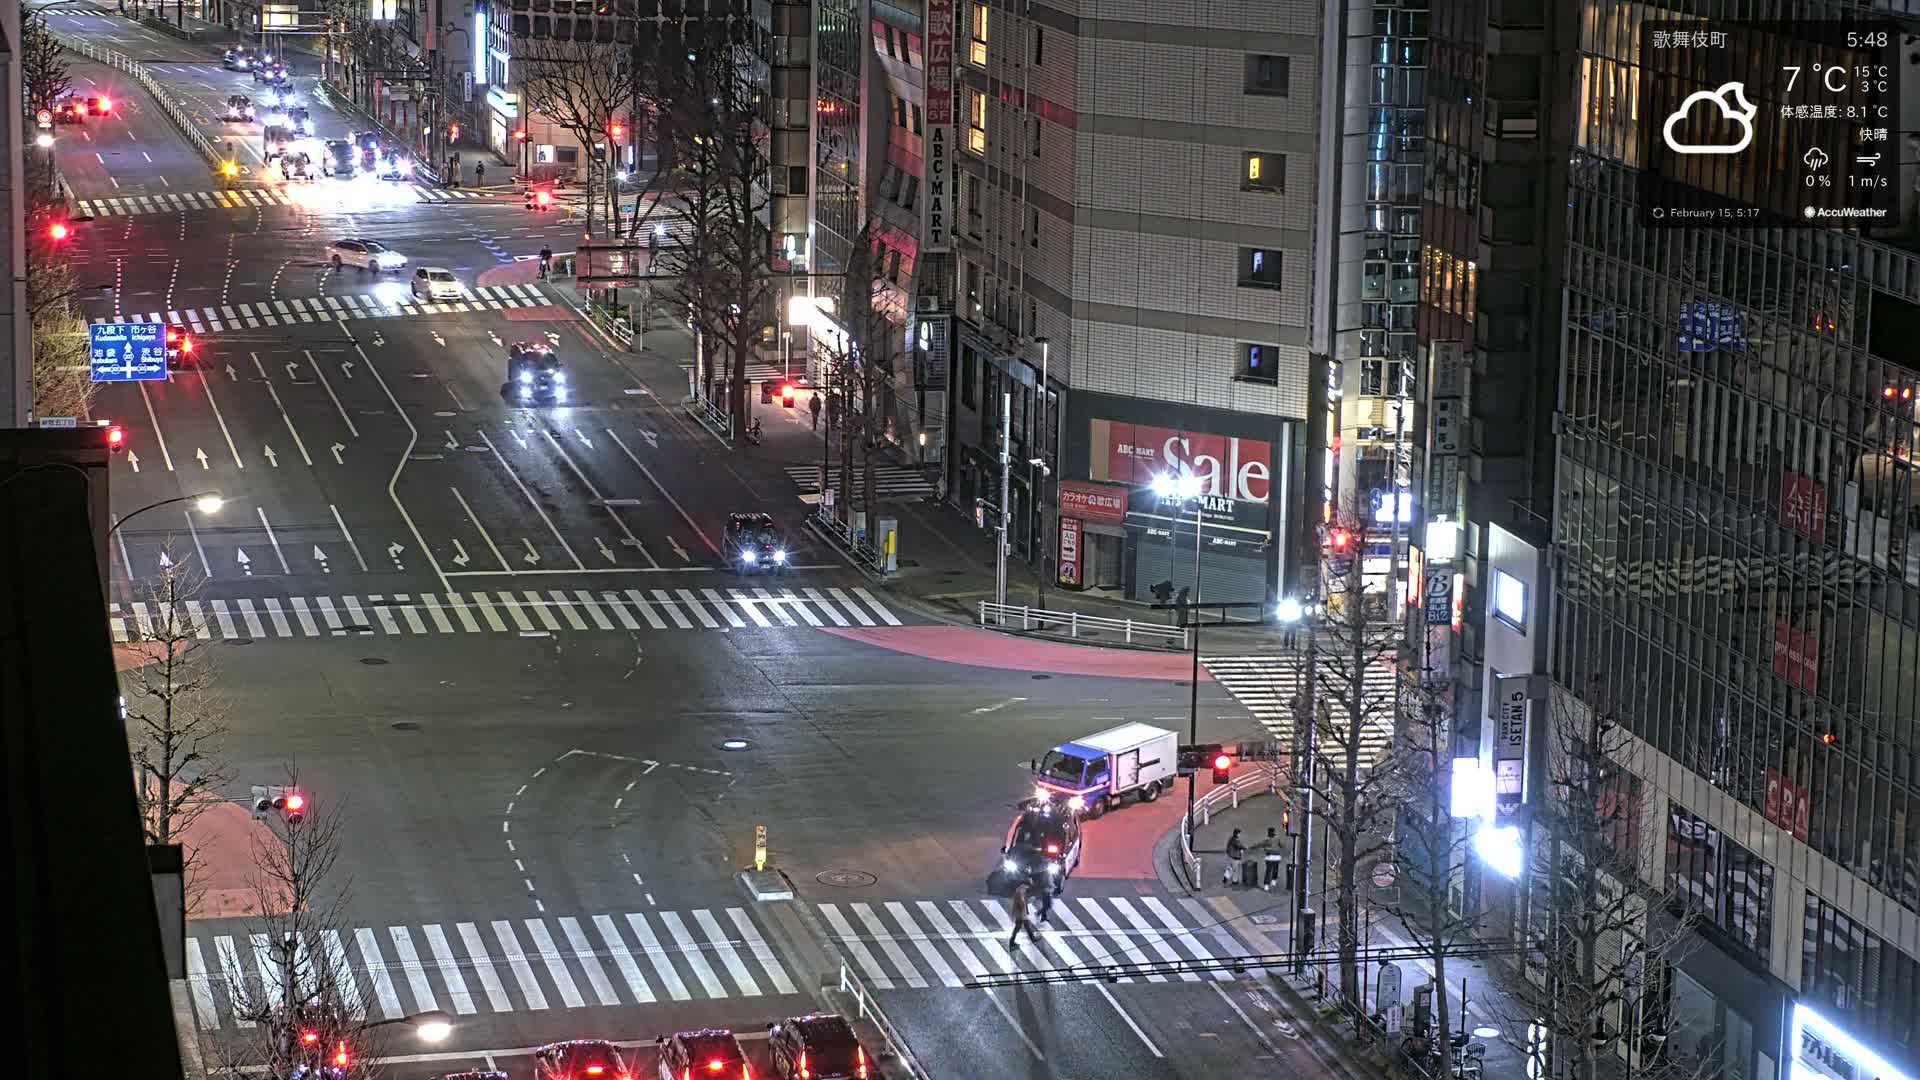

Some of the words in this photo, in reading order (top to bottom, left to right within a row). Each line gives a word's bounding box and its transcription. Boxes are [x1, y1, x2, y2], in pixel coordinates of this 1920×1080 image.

[930, 127, 944, 244] ABC-MART
[1117, 443, 1155, 457] ABCMART
[1163, 436, 1271, 503] Sale
[1510, 705, 1523, 746] ISETAN
